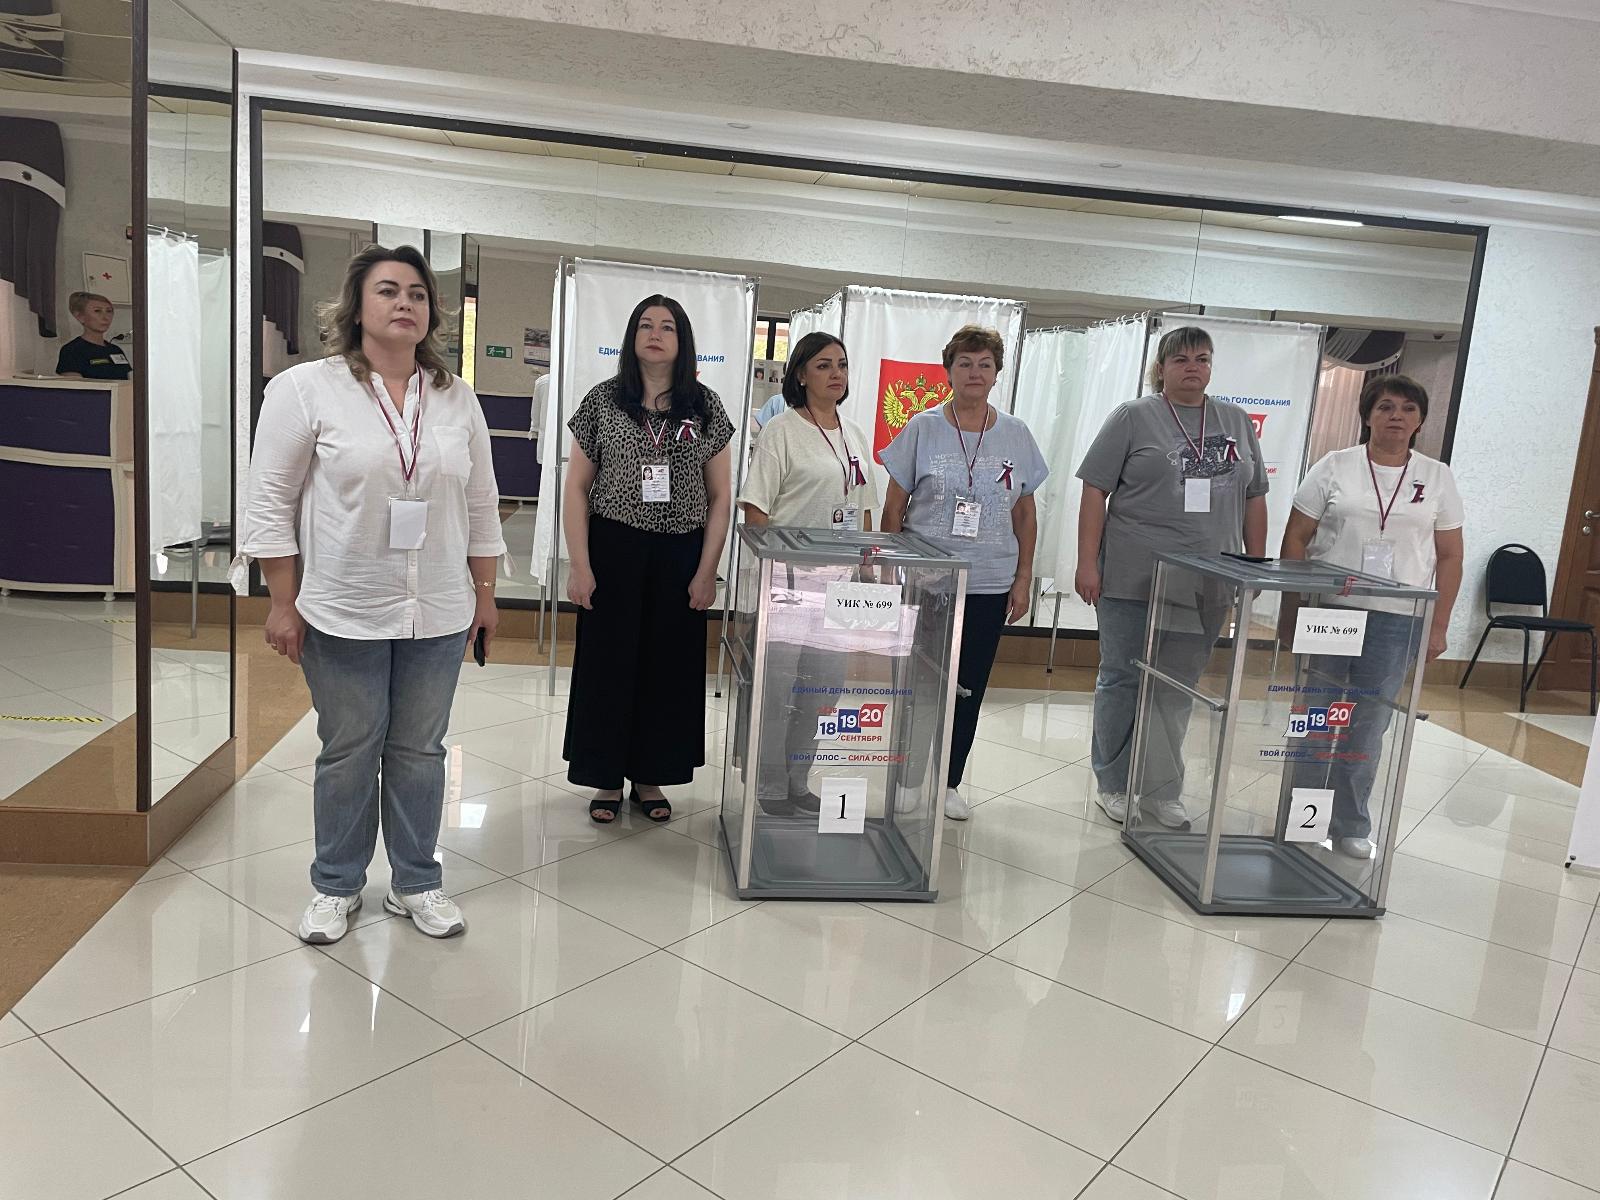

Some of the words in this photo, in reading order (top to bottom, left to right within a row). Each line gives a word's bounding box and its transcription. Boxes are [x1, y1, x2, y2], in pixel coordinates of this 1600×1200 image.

[598, 347, 623, 356] ЕДИН
[1231, 396, 1291, 406] ГОЛОСОВАНИЯ
[837, 598, 860, 608] УИК
[863, 600, 874, 609] №
[876, 600, 893, 609] 699
[1306, 624, 1329, 634] УИК
[1330, 626, 1341, 635] №
[1342, 627, 1358, 635] 699
[792, 686, 827, 695] ЕДИНЫЙ
[828, 687, 851, 695] ДЕНЬ
[852, 687, 913, 696] ГОЛОСОВАНИЯ
[1268, 684, 1301, 693] ЕДИНЫЙ
[861, 708, 881, 722] 20
[1310, 713, 1325, 726] 19
[1329, 708, 1349, 721] 20
[840, 715, 857, 728] 19
[1290, 720, 1305, 732] 18
[820, 722, 836, 735] 18
[840, 734, 882, 742] СЕНТЯБРЯ
[1260, 749, 1280, 757] ТВОЙ
[871, 755, 905, 763] РОСС
[837, 793, 847, 819] 1
[1300, 804, 1318, 828] 2
